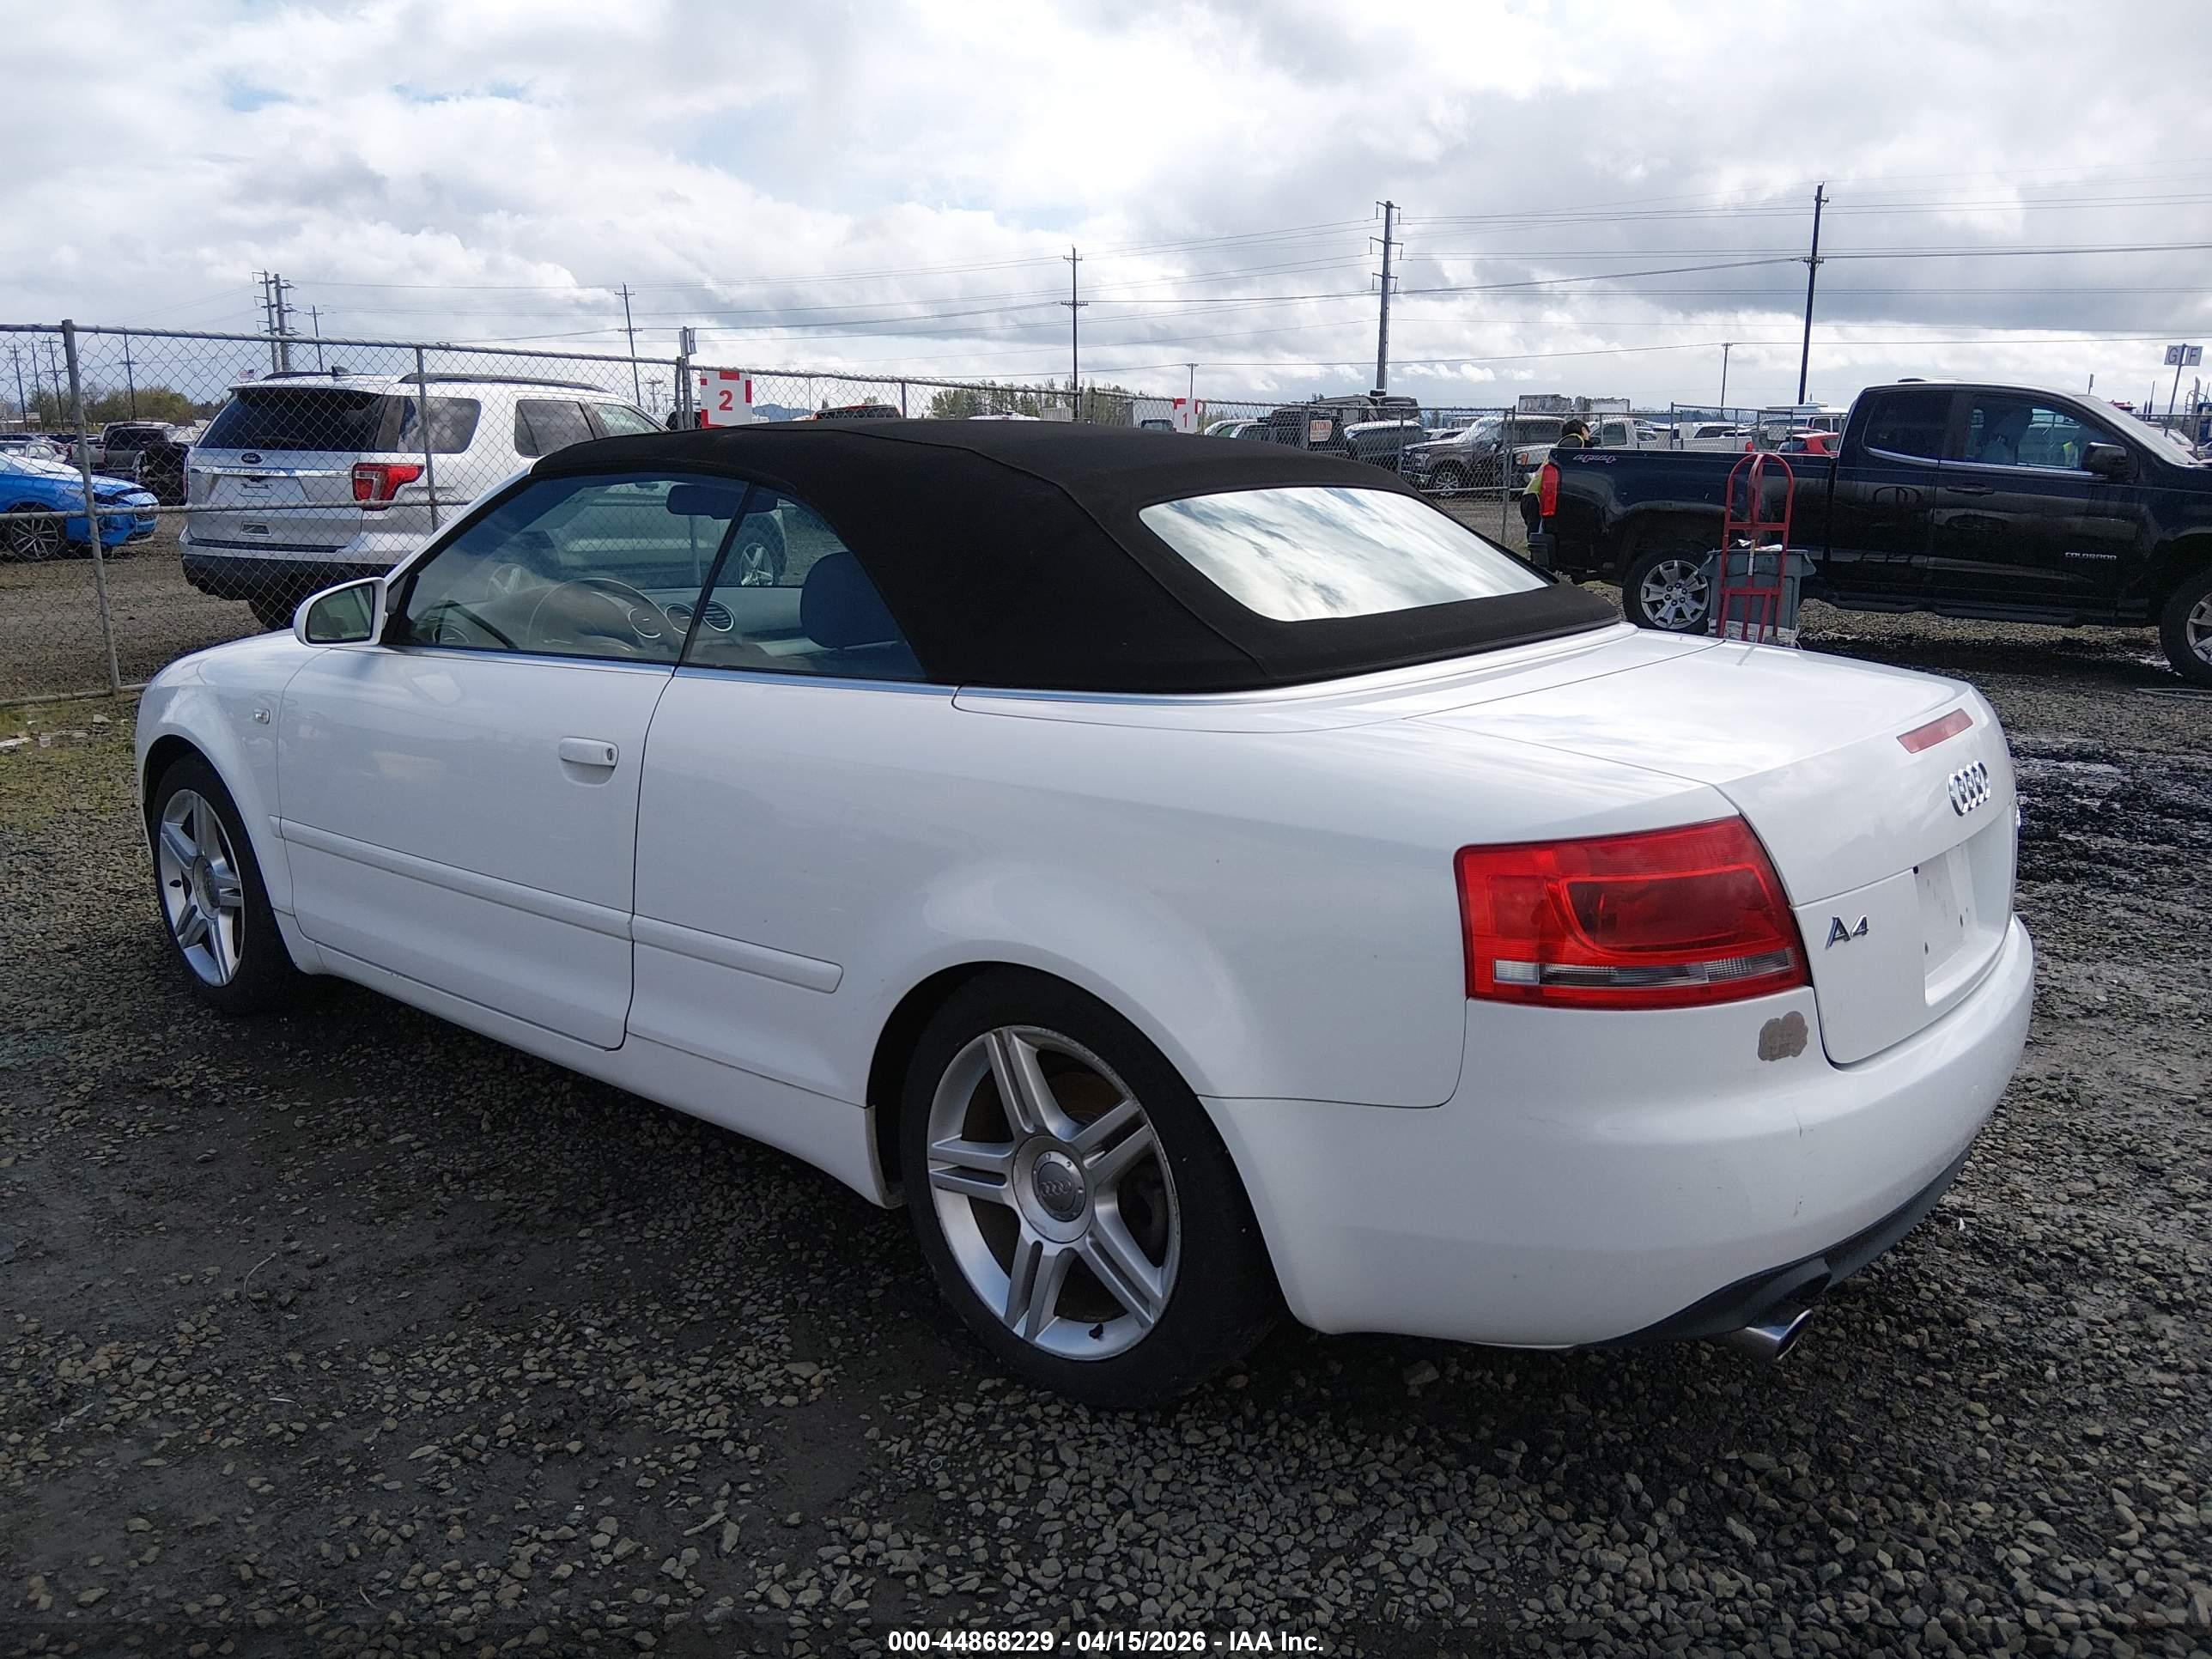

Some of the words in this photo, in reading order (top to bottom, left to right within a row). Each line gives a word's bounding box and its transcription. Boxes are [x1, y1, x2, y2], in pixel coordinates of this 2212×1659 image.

[2167, 347, 2179, 364] G
[2188, 348, 2199, 365] F
[719, 390, 733, 411] 2
[1182, 412, 1188, 428] 1
[2064, 552, 2117, 561] COLORADO
[1825, 915, 1869, 950] A4
